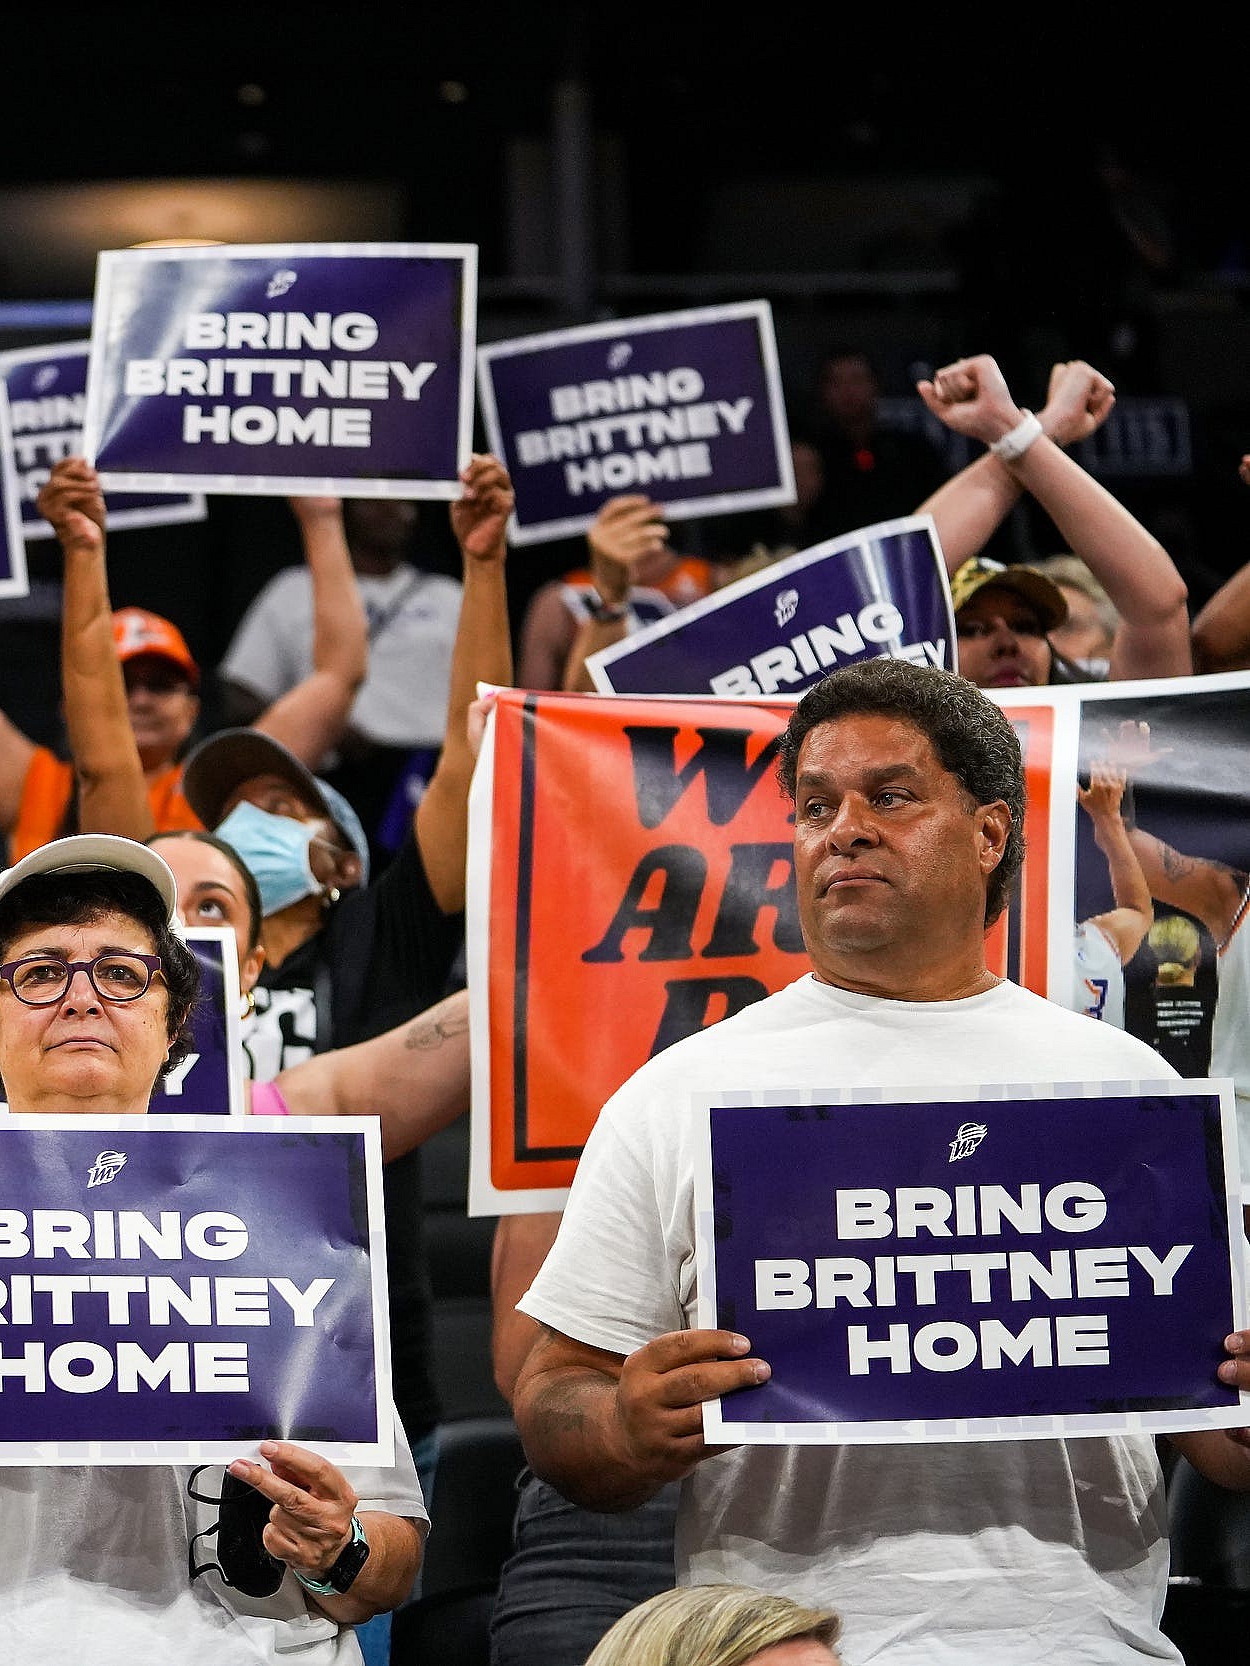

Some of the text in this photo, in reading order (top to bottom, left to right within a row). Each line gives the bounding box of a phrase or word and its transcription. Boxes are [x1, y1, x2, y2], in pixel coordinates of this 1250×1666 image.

[183, 312, 378, 351] BRING
[125, 358, 437, 401] BRITTNEY
[551, 367, 705, 422] BRING
[183, 405, 372, 447] HOME
[515, 396, 753, 467] BRITTNEY
[564, 442, 713, 496] HOME
[709, 602, 904, 695] BRING
[623, 726, 796, 829] W
[582, 842, 807, 963] AR
[836, 1181, 1108, 1240] BRING
[754, 1244, 1195, 1311] BRITTNEY
[847, 1314, 1110, 1376] HOME
